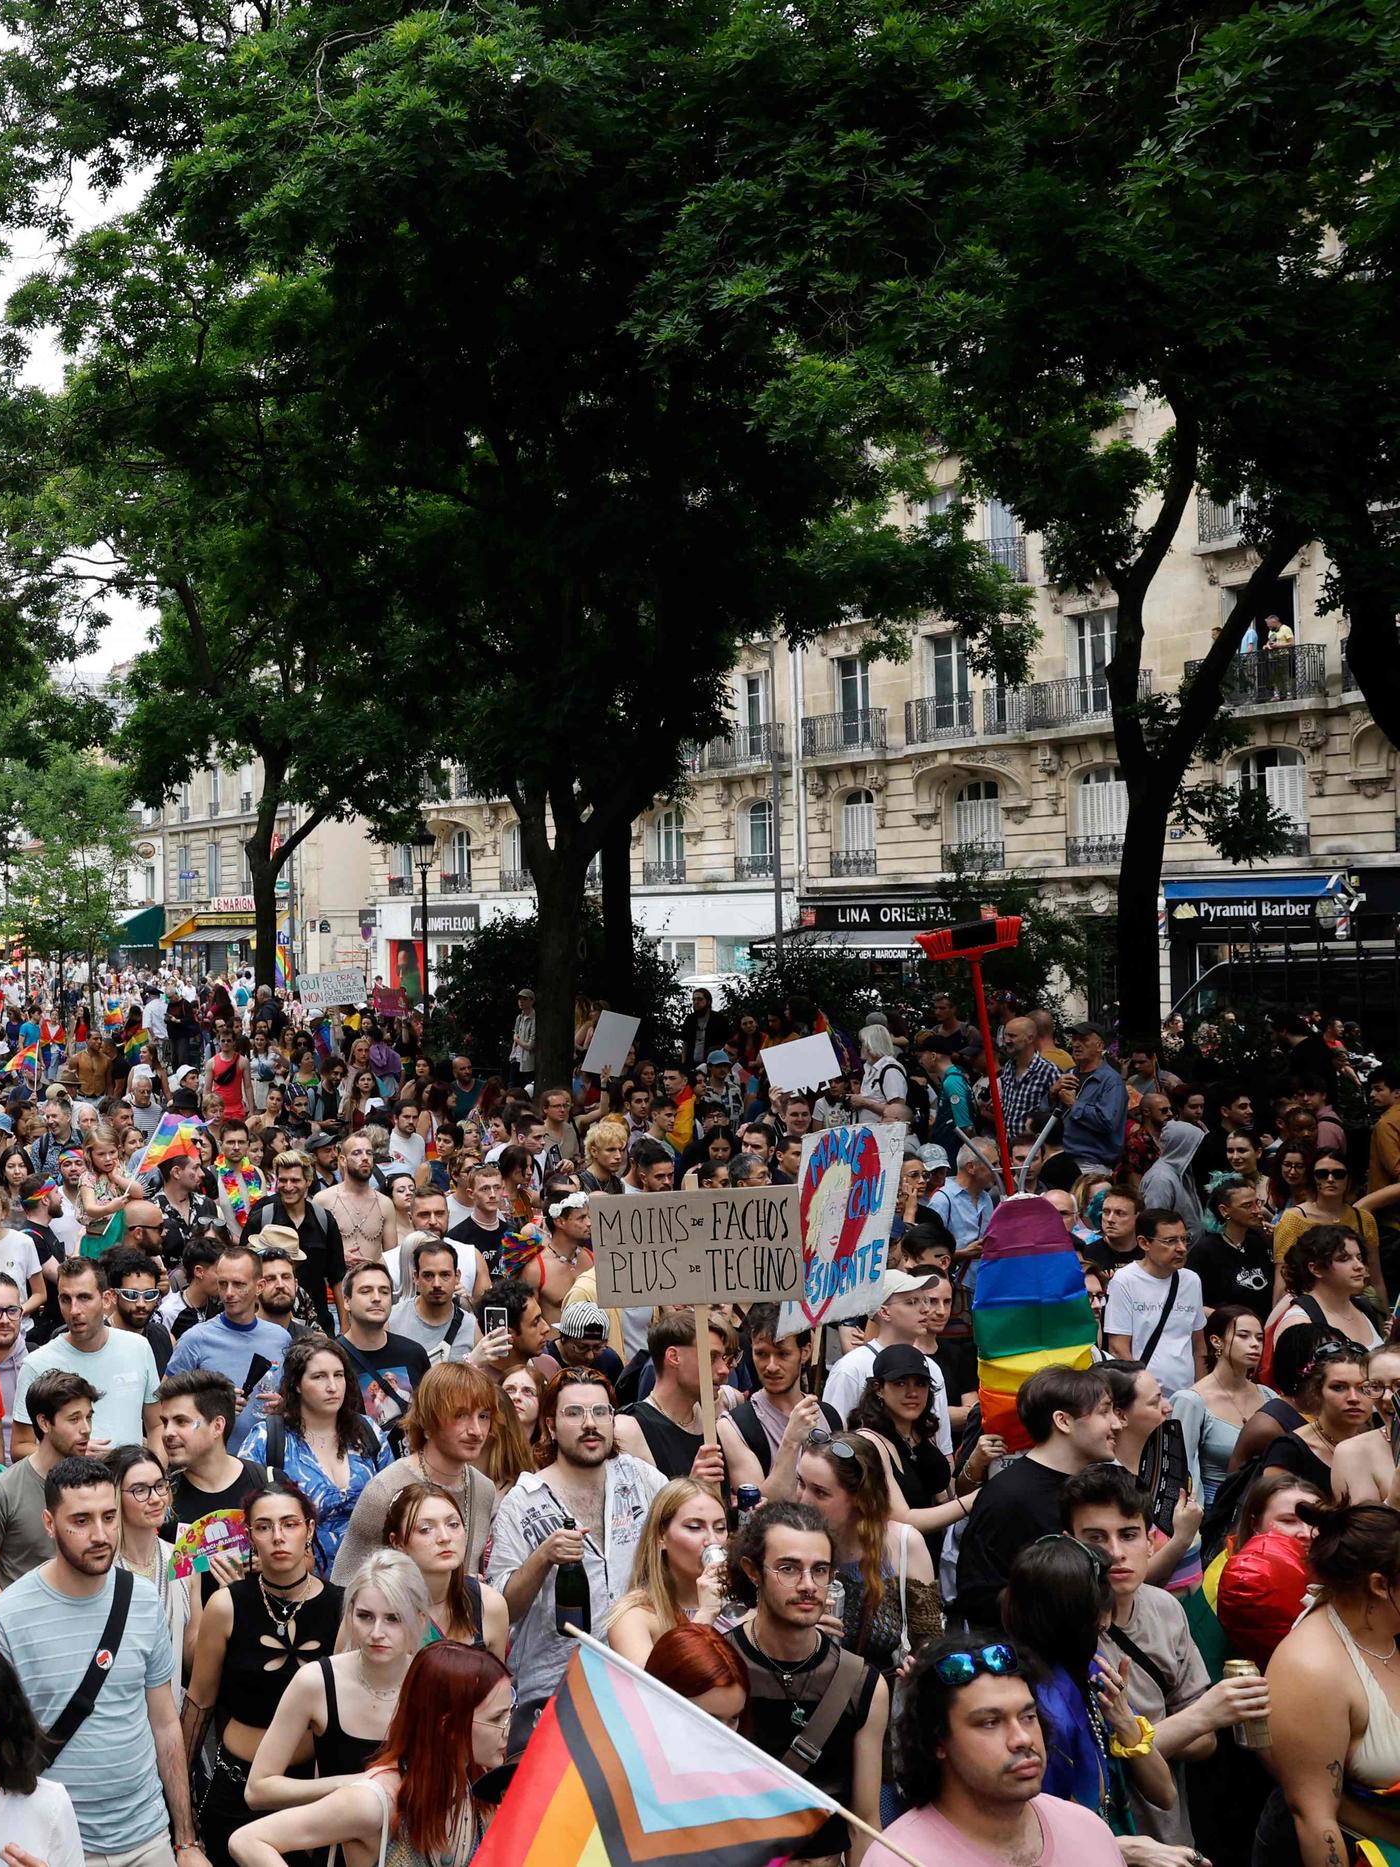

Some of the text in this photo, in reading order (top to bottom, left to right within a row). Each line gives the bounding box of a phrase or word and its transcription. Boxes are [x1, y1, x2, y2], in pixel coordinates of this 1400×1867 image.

[223, 898, 255, 911] MARIGN
[1200, 901, 1310, 921] Pyramid Barber
[838, 906, 957, 923] LINA ORIENTAL
[875, 949, 907, 959] MAROCAIN
[301, 976, 320, 990] OUI
[304, 991, 323, 1003] NON
[810, 1127, 873, 1188] MARIE
[849, 1169, 886, 1219] CAU
[600, 1198, 788, 1246] MOINS DE FACHOS
[610, 1248, 797, 1294] PLUS DE TECHNO
[790, 1239, 885, 1312] ESIDENTE
[1132, 1301, 1157, 1312] Calvin
